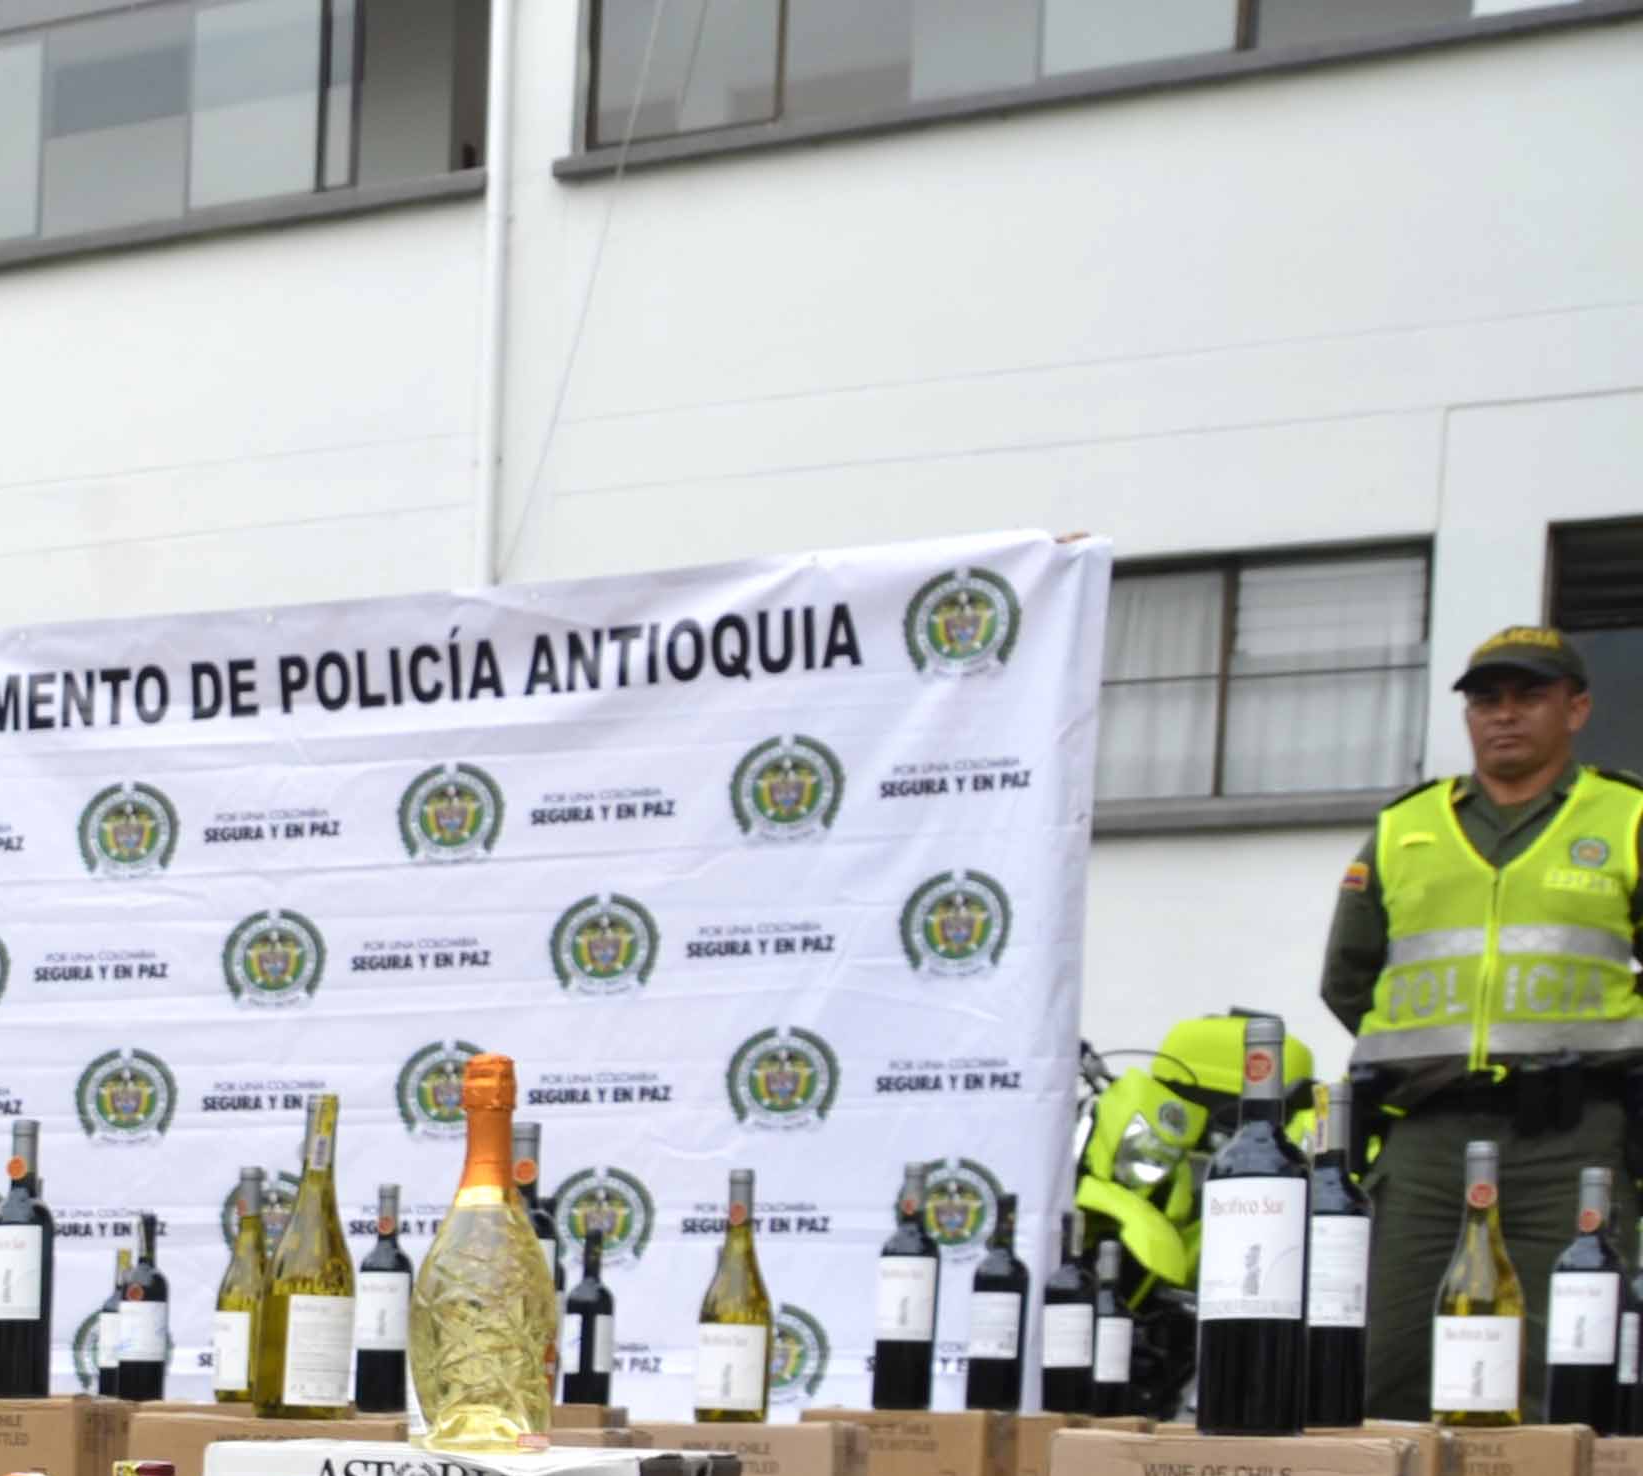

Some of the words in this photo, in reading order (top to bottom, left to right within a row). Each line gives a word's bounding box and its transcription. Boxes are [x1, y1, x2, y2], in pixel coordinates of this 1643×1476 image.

[191, 659, 260, 720] DE
[279, 626, 505, 713] POLICÍA
[524, 602, 862, 696] ANTIOQUIA
[880, 779, 947, 799] SEGURA
[954, 778, 966, 793] Y
[972, 775, 995, 791] EN
[1001, 771, 1032, 789] PAZ
[530, 806, 594, 825] SEGURA
[600, 806, 611, 820] Y
[617, 803, 638, 819] EN
[643, 800, 676, 818] PAZ
[204, 826, 264, 843] SEGURA
[270, 825, 279, 838] Y
[285, 823, 305, 838] EN
[310, 820, 341, 838] PAZ
[686, 940, 753, 959] SEGURA
[758, 940, 769, 955] Y
[774, 938, 797, 954] EN
[803, 934, 835, 953] PAZ
[351, 953, 413, 971] SEGURA
[419, 953, 429, 967] Y
[434, 952, 454, 967] EN
[460, 949, 492, 967] PAZ
[34, 965, 95, 982] SEGURA
[99, 965, 110, 979] Y
[114, 963, 135, 978] EN
[141, 961, 169, 978] PAZ
[1388, 958, 1606, 1021] POLICIA
[876, 1073, 943, 1093] SEGURA
[949, 1074, 960, 1089] Y
[964, 1072, 985, 1089] EN
[991, 1071, 1021, 1089] PAZ
[203, 1094, 263, 1112] SEGURA
[269, 1094, 279, 1109] Y
[285, 1093, 303, 1108] EN
[528, 1088, 591, 1105] SEGURA
[597, 1088, 607, 1103] Y
[612, 1087, 633, 1102] EN
[639, 1084, 672, 1102] PAZ
[770, 1218, 793, 1232] EN
[798, 1217, 830, 1232] PAZ
